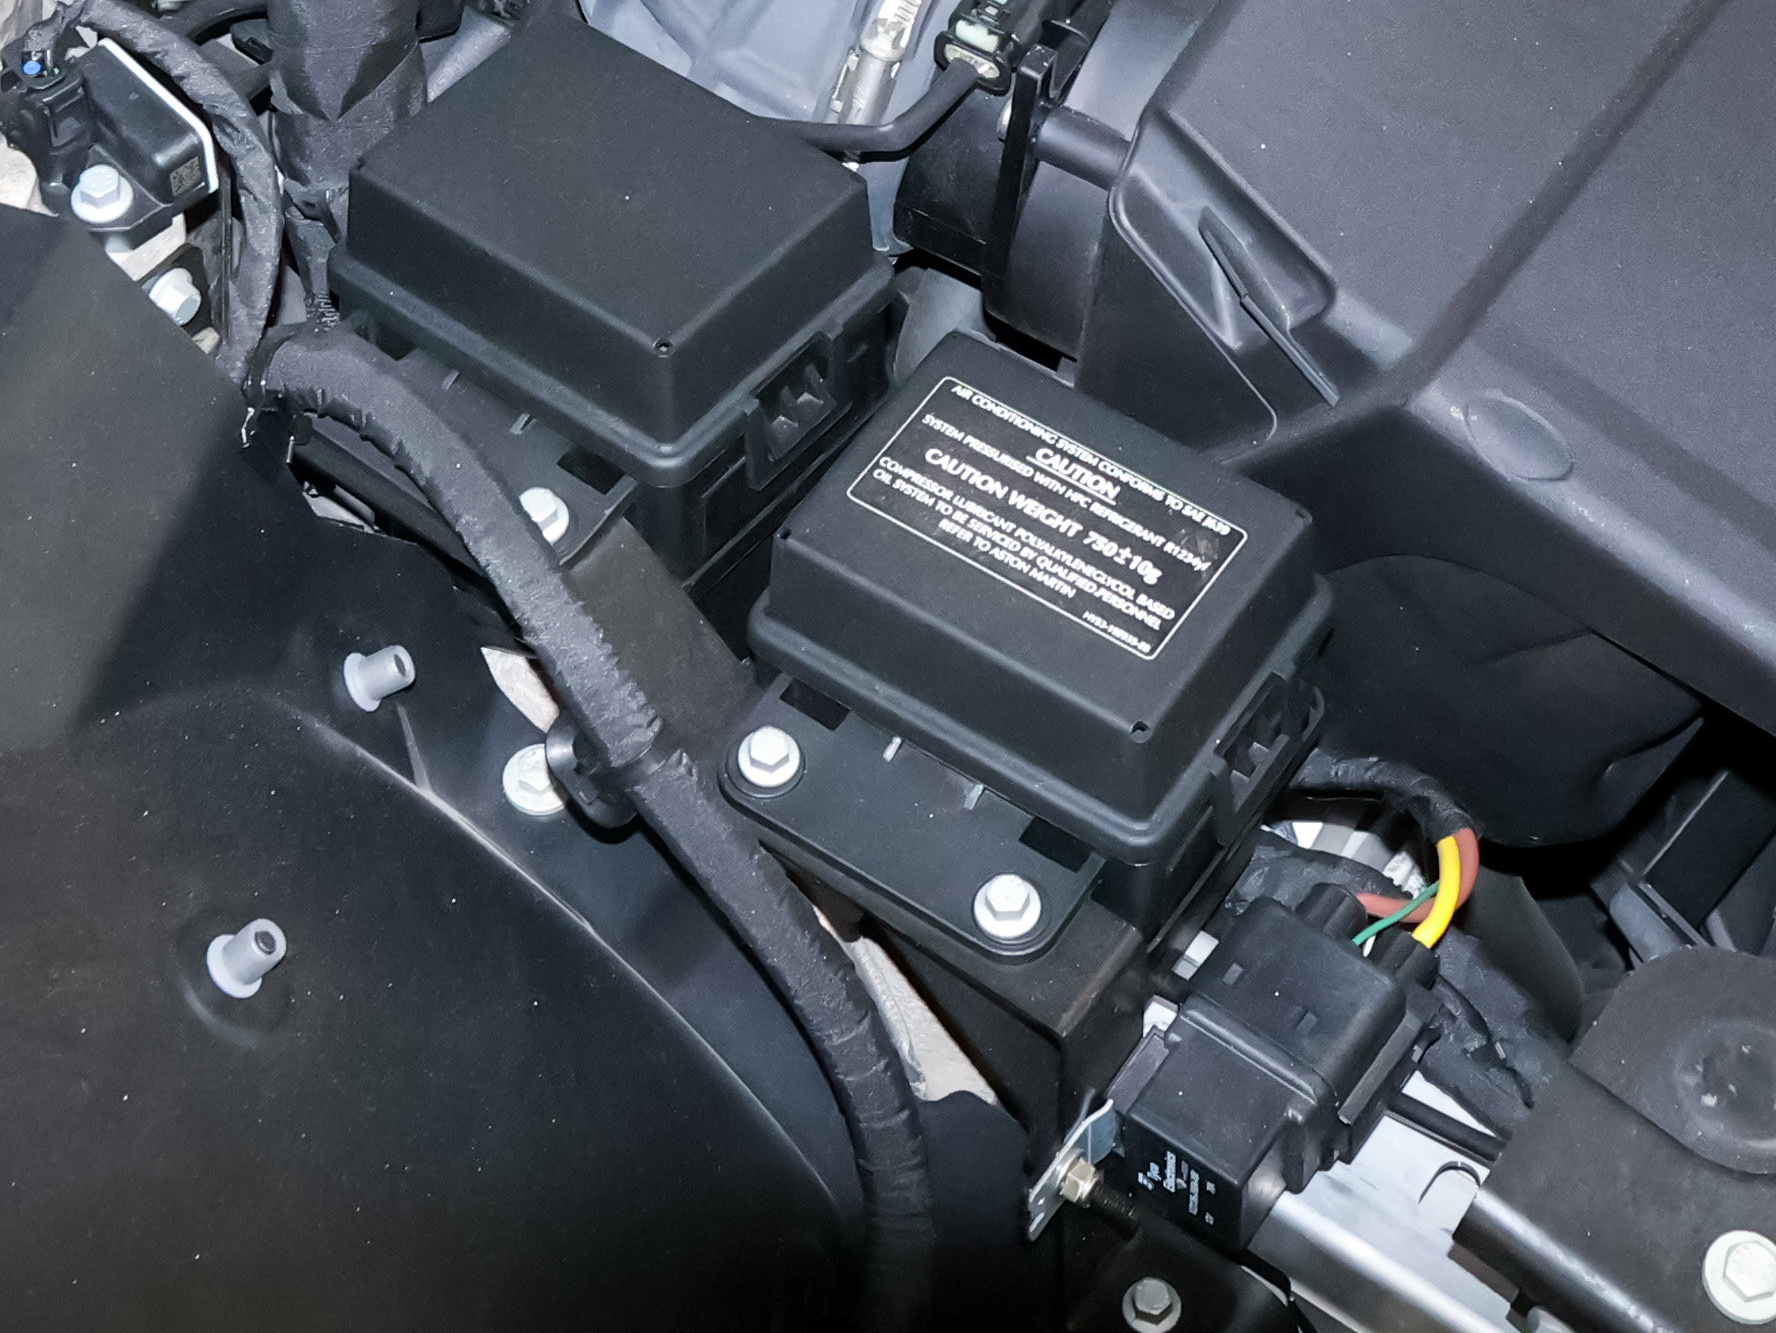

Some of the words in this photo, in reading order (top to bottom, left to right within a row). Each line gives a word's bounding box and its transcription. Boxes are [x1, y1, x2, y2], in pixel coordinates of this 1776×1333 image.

[921, 413, 966, 442] SYSTEM
[962, 434, 1035, 478] PRESSURISED
[1032, 470, 1068, 496] WITH
[1088, 501, 1167, 548] REFRIGERANT
[924, 447, 1010, 500] CAUTION
[1007, 489, 1084, 538] WEIGHT
[950, 384, 974, 401] AIR
[971, 393, 1059, 445] CONDITIONING
[1054, 437, 1100, 467] SYSTEM
[1097, 460, 1167, 502] CONFORMS
[1164, 493, 1184, 511] TO
[1180, 504, 1207, 523] SAE
[1034, 447, 1122, 501] CAUTION
[872, 468, 893, 486] OIL
[891, 478, 937, 508] SYSTEM
[934, 499, 954, 516] TO
[950, 509, 970, 525] BE
[965, 517, 1023, 553] SERVICED
[1018, 545, 1040, 561] BY
[878, 456, 955, 502] COMPRESSOR
[951, 494, 1018, 534] LUBRICANT
[1135, 592, 1176, 621] BASED
[937, 517, 975, 544] REFER
[972, 535, 993, 553] TO
[987, 546, 1032, 574] ASTON
[1027, 566, 1077, 599] MARTIN
